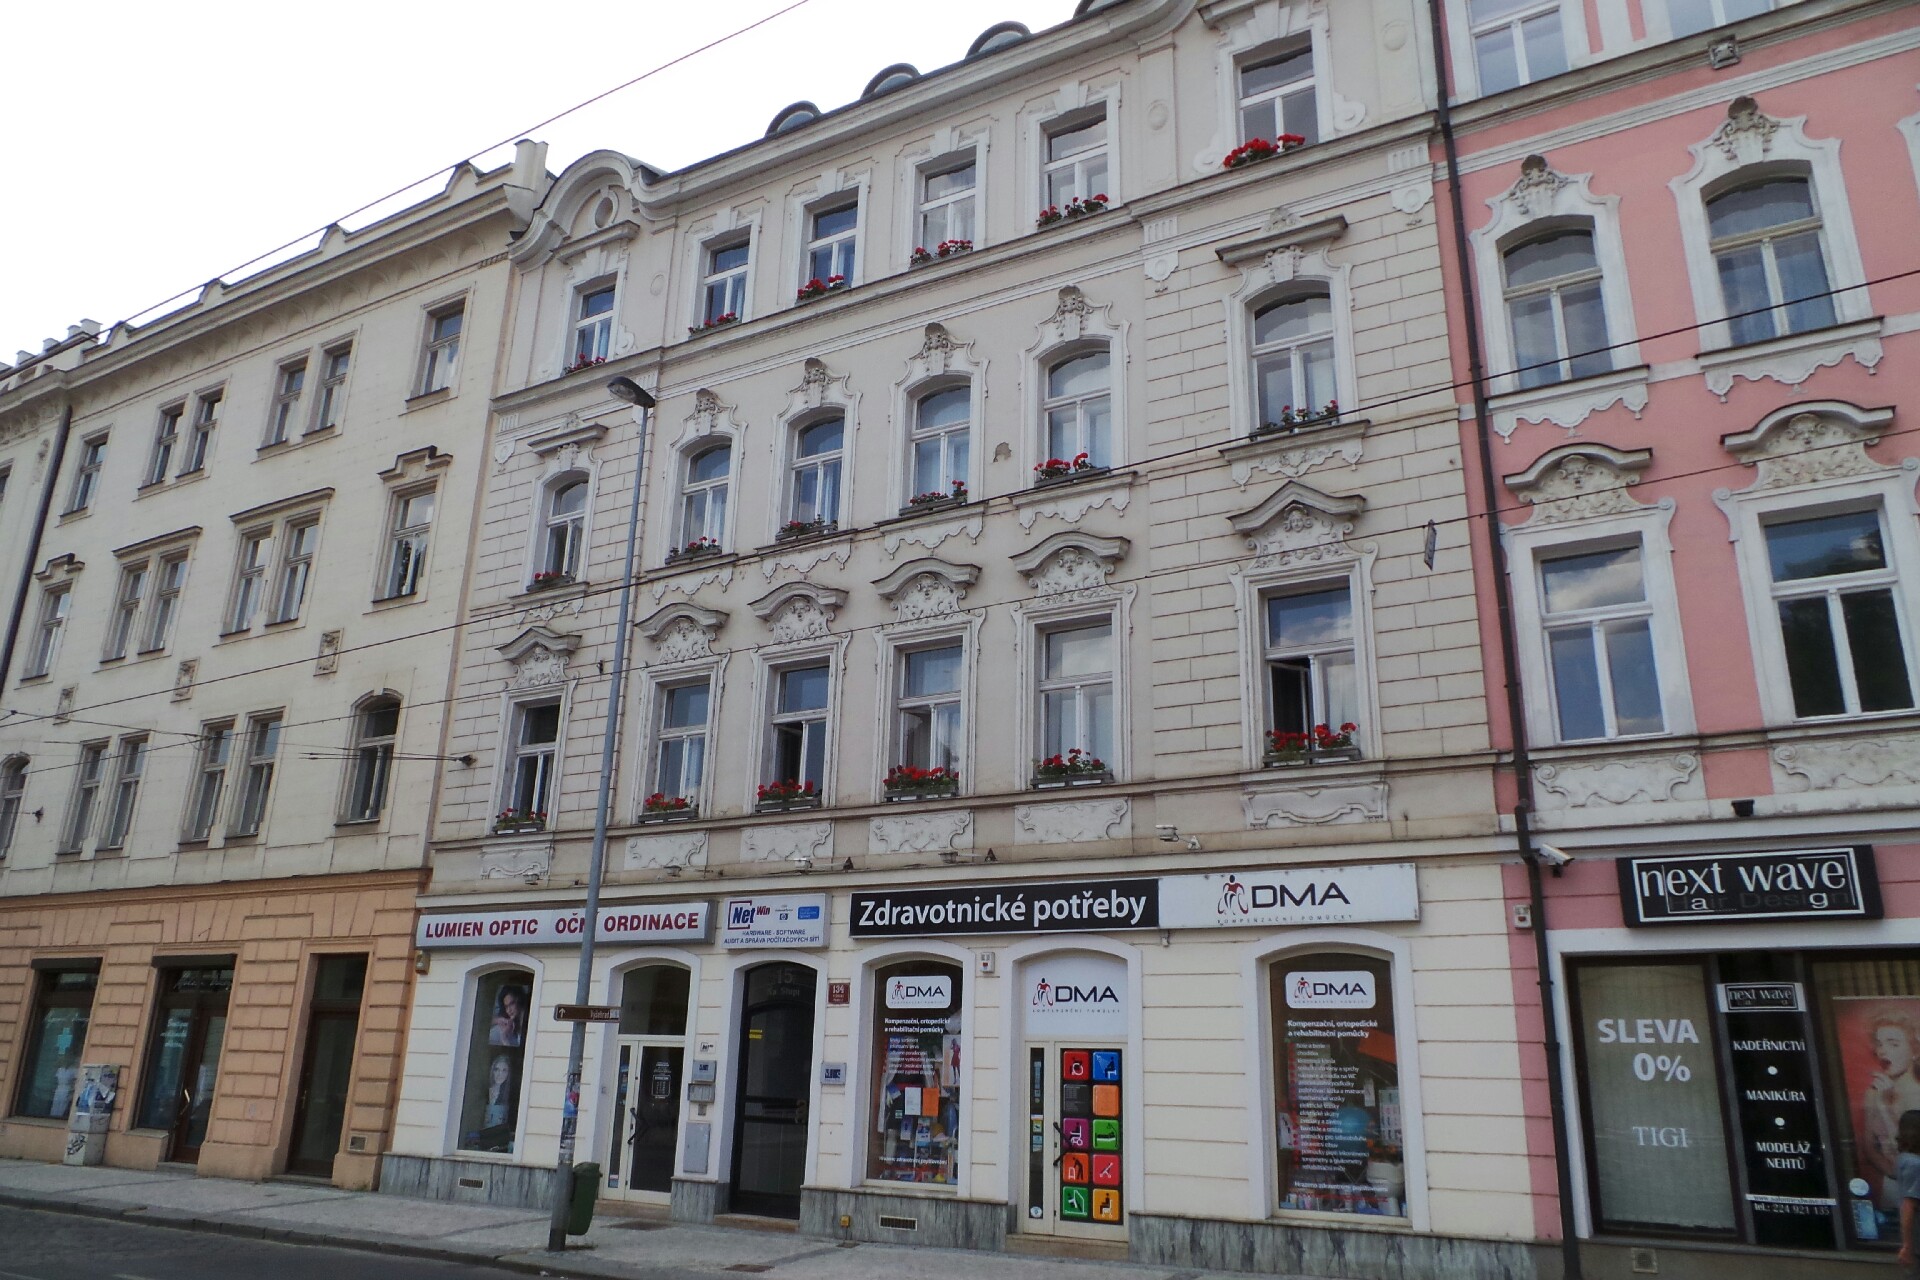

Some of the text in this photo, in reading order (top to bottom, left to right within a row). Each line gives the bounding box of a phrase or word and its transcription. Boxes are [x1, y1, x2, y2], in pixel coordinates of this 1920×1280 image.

[1642, 860, 1846, 898] next wave
[1252, 882, 1350, 908] DMA
[732, 907, 756, 924] Net
[756, 906, 770, 915] Win
[859, 890, 1146, 927] Zdravotnické potřeby
[425, 919, 538, 938] LUMIEN OPTIC
[604, 912, 699, 932] ORDINACE
[832, 984, 845, 994] 134
[906, 986, 945, 997] DMA
[1056, 986, 1119, 1002] DMA
[1313, 982, 1367, 996] DMA
[1729, 989, 1792, 1000] next wave
[1288, 1020, 1378, 1028] Kompenzační, ortopedické
[1598, 1018, 1700, 1044] SLEVA
[1294, 1029, 1336, 1037] rehabilitační
[1337, 1030, 1369, 1038] pomůcky
[1733, 1038, 1806, 1051] KADEŘNICTVÍ
[1634, 1052, 1691, 1082] 0%
[1746, 1088, 1806, 1102] MANIKÚRA
[1633, 1126, 1689, 1148] TIGI
[1756, 1141, 1811, 1154] MODELÁŽ
[1766, 1157, 1806, 1170] NEHTŮ
[1772, 1204, 1789, 1213] 224
